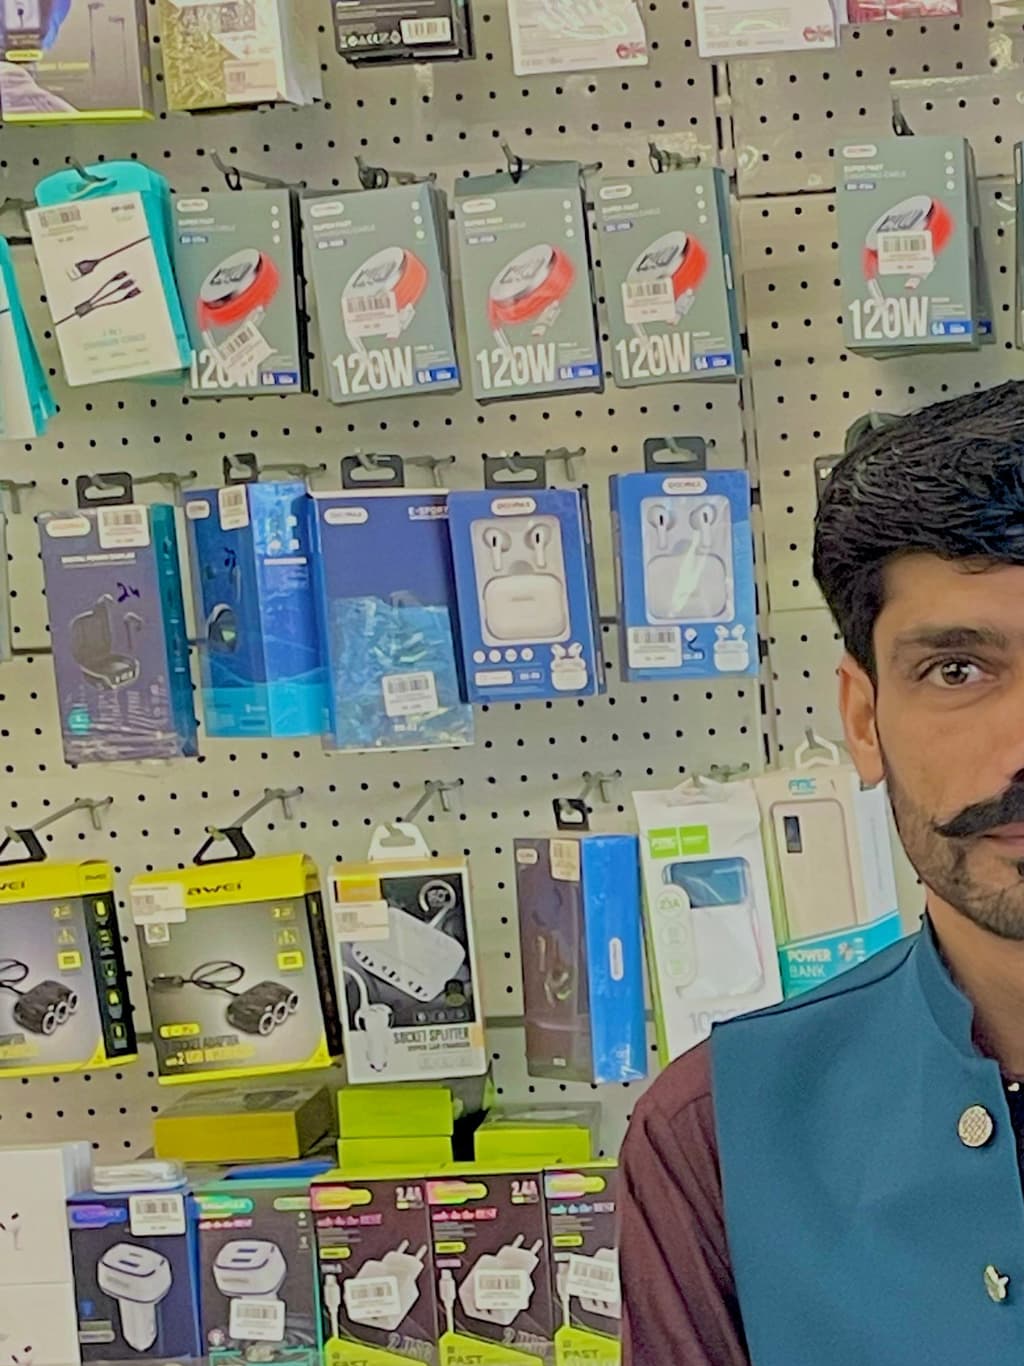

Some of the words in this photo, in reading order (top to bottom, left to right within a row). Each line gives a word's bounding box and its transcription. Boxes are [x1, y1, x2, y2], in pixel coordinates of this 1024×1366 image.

[848, 296, 929, 341] 120W
[332, 345, 414, 394] 120W
[476, 342, 556, 389] 120W
[615, 332, 691, 380] 120W
[787, 949, 832, 963] POWER
[789, 965, 826, 979] BANK
[447, 1354, 484, 1365] FAST
[562, 1349, 600, 1359] FAST
